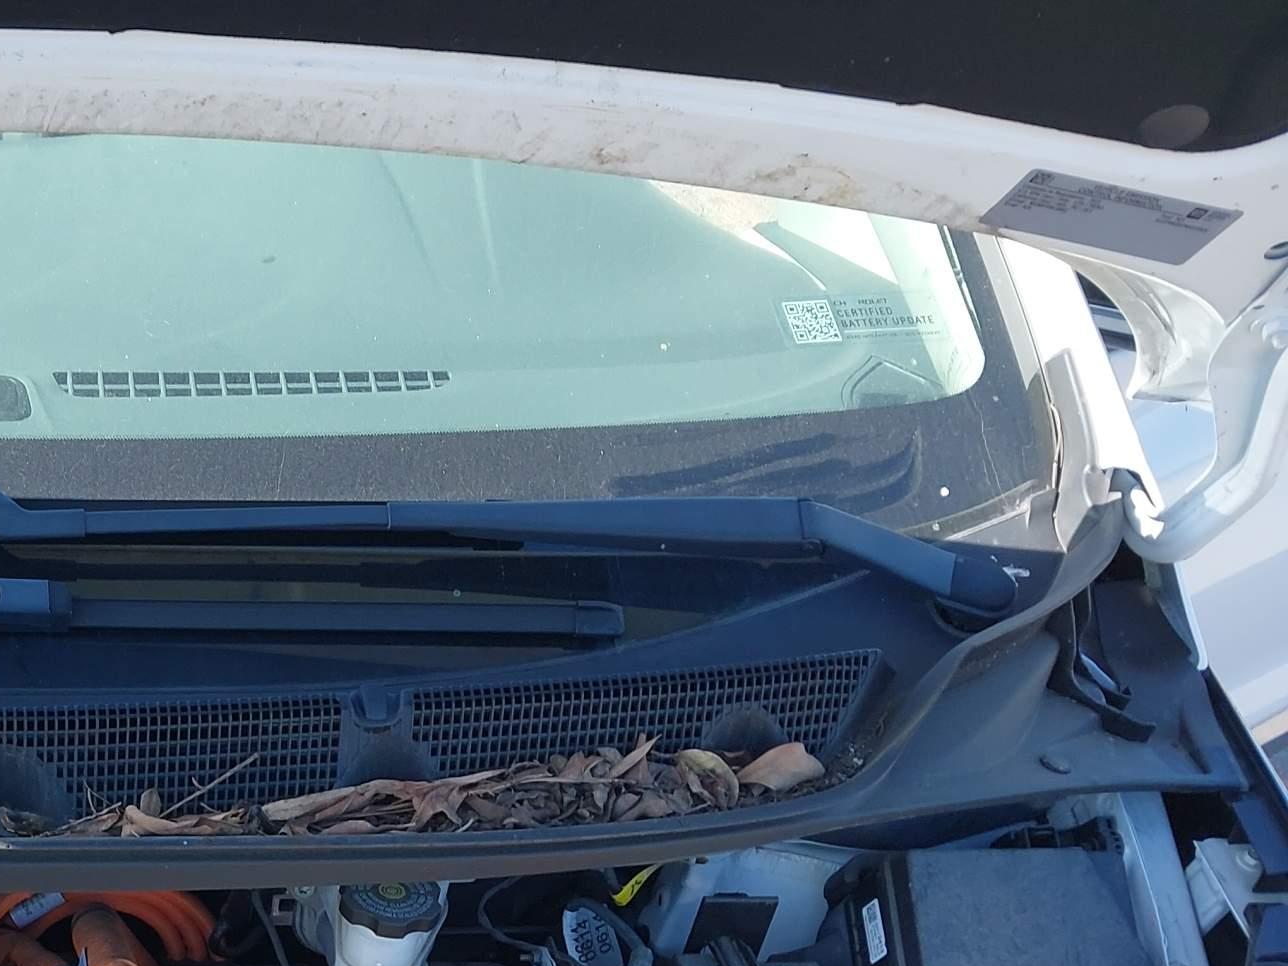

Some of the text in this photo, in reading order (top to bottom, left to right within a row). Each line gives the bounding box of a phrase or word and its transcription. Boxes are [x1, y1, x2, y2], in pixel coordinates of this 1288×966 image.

[837, 306, 893, 318] CERTIFIED
[841, 315, 935, 329] BATTERY UPDATE
